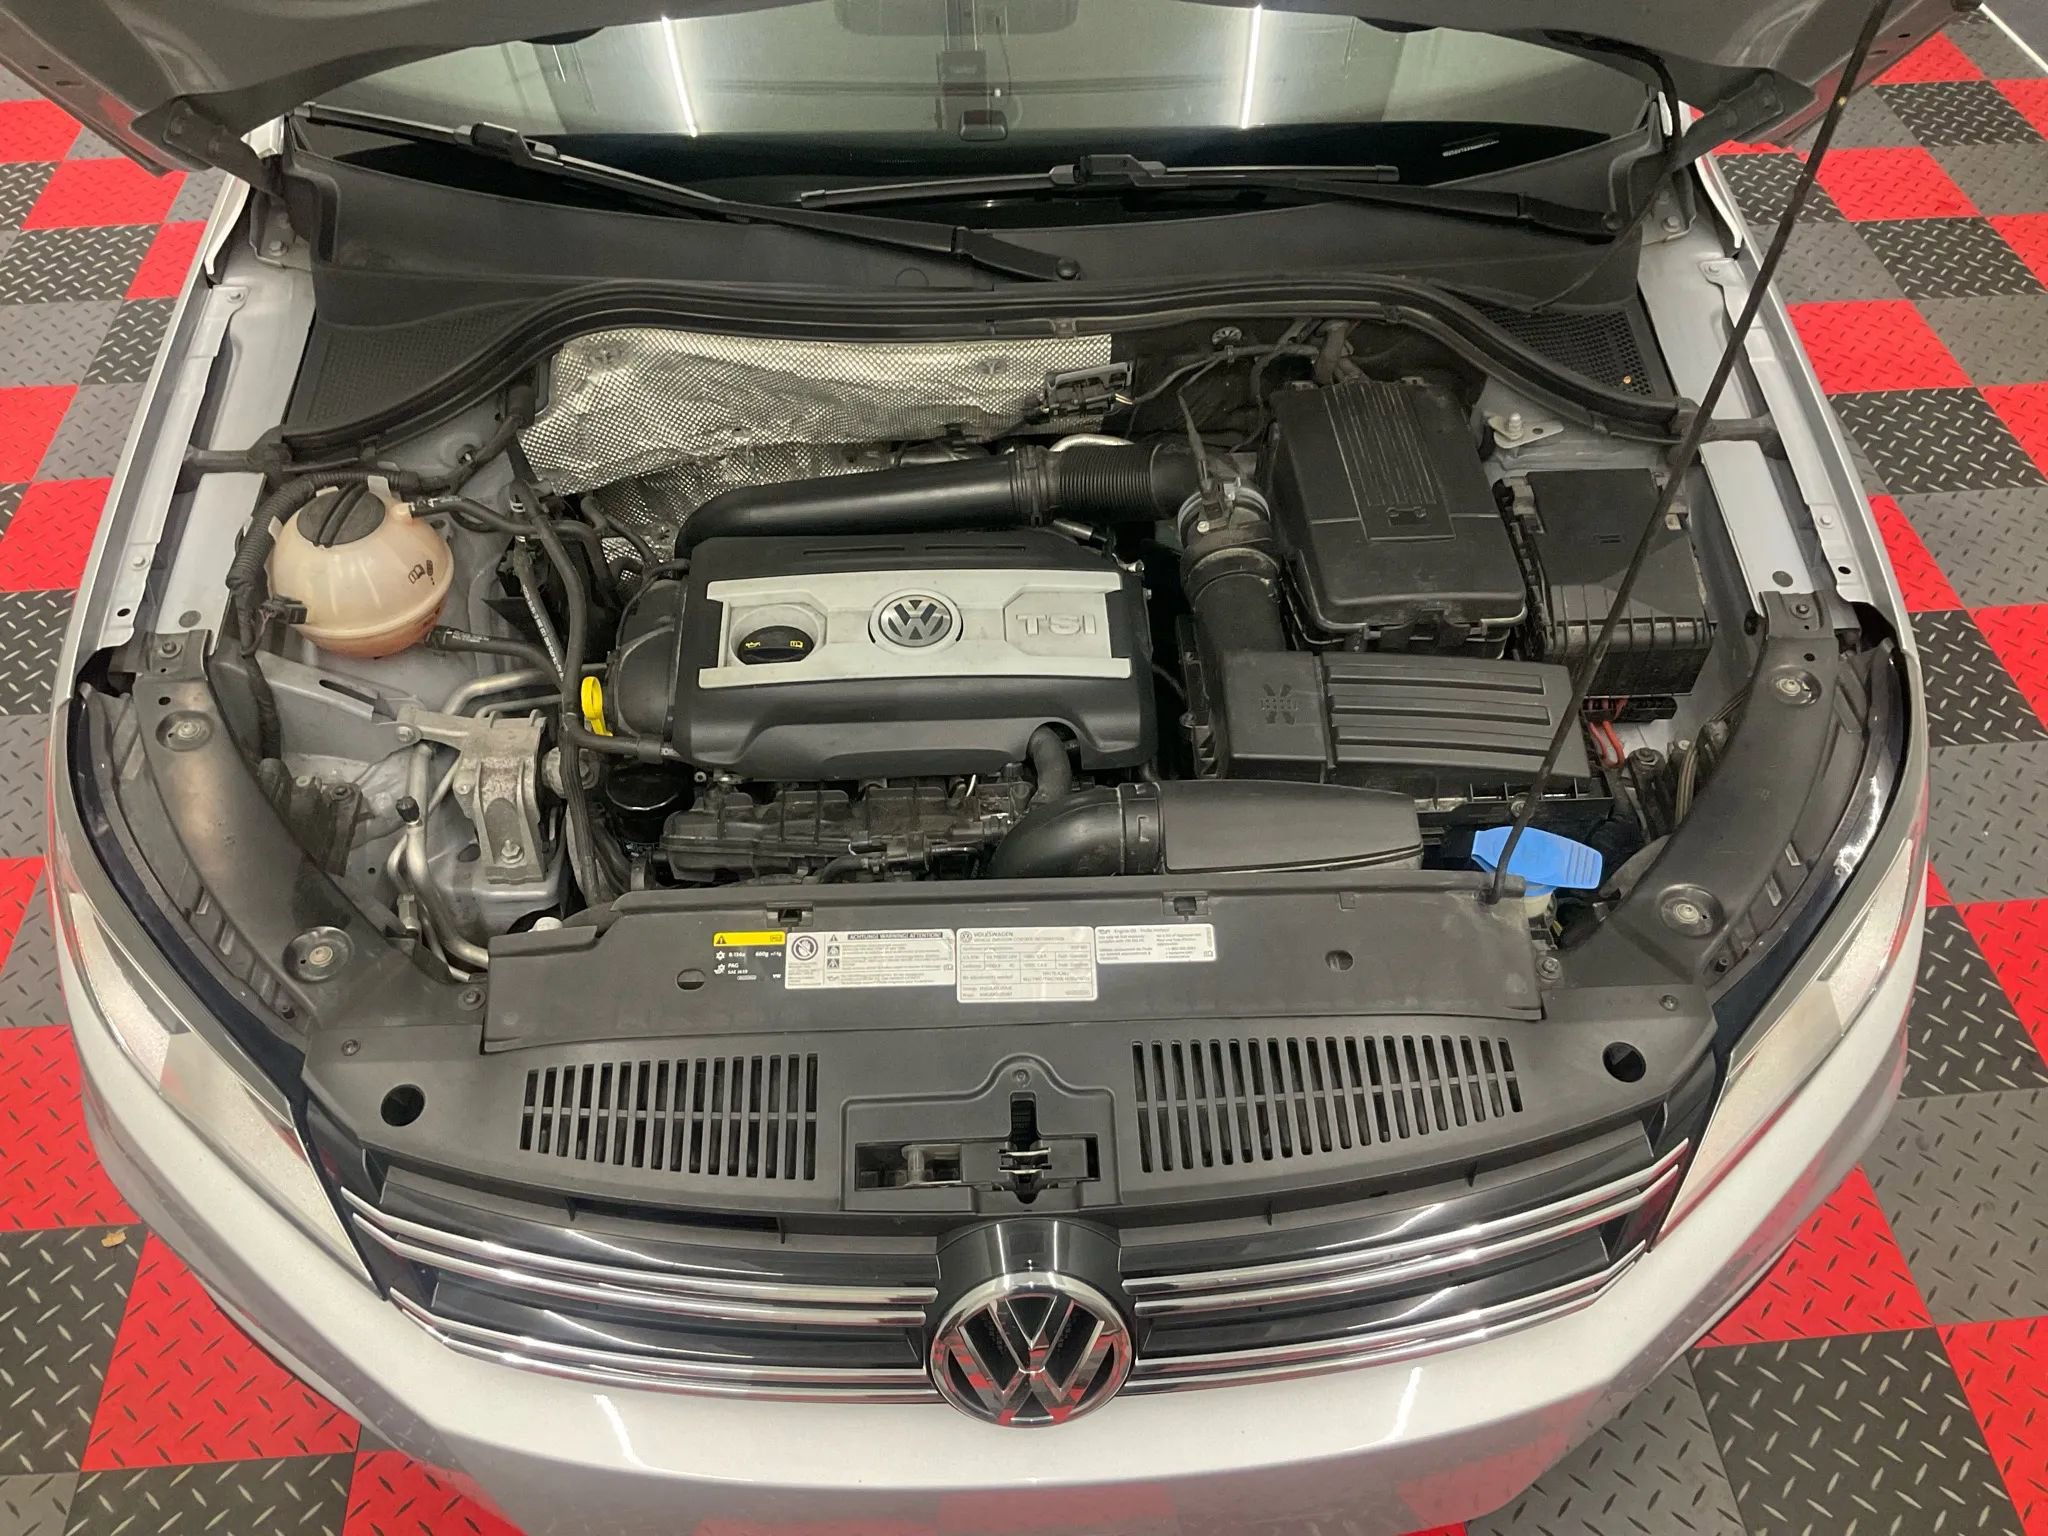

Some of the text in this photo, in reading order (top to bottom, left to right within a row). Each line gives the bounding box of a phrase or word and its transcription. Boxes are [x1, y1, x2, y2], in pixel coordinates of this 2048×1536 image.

[880, 595, 952, 647] VW
[1016, 613, 1098, 637] TSI
[934, 1277, 1129, 1427] VW
